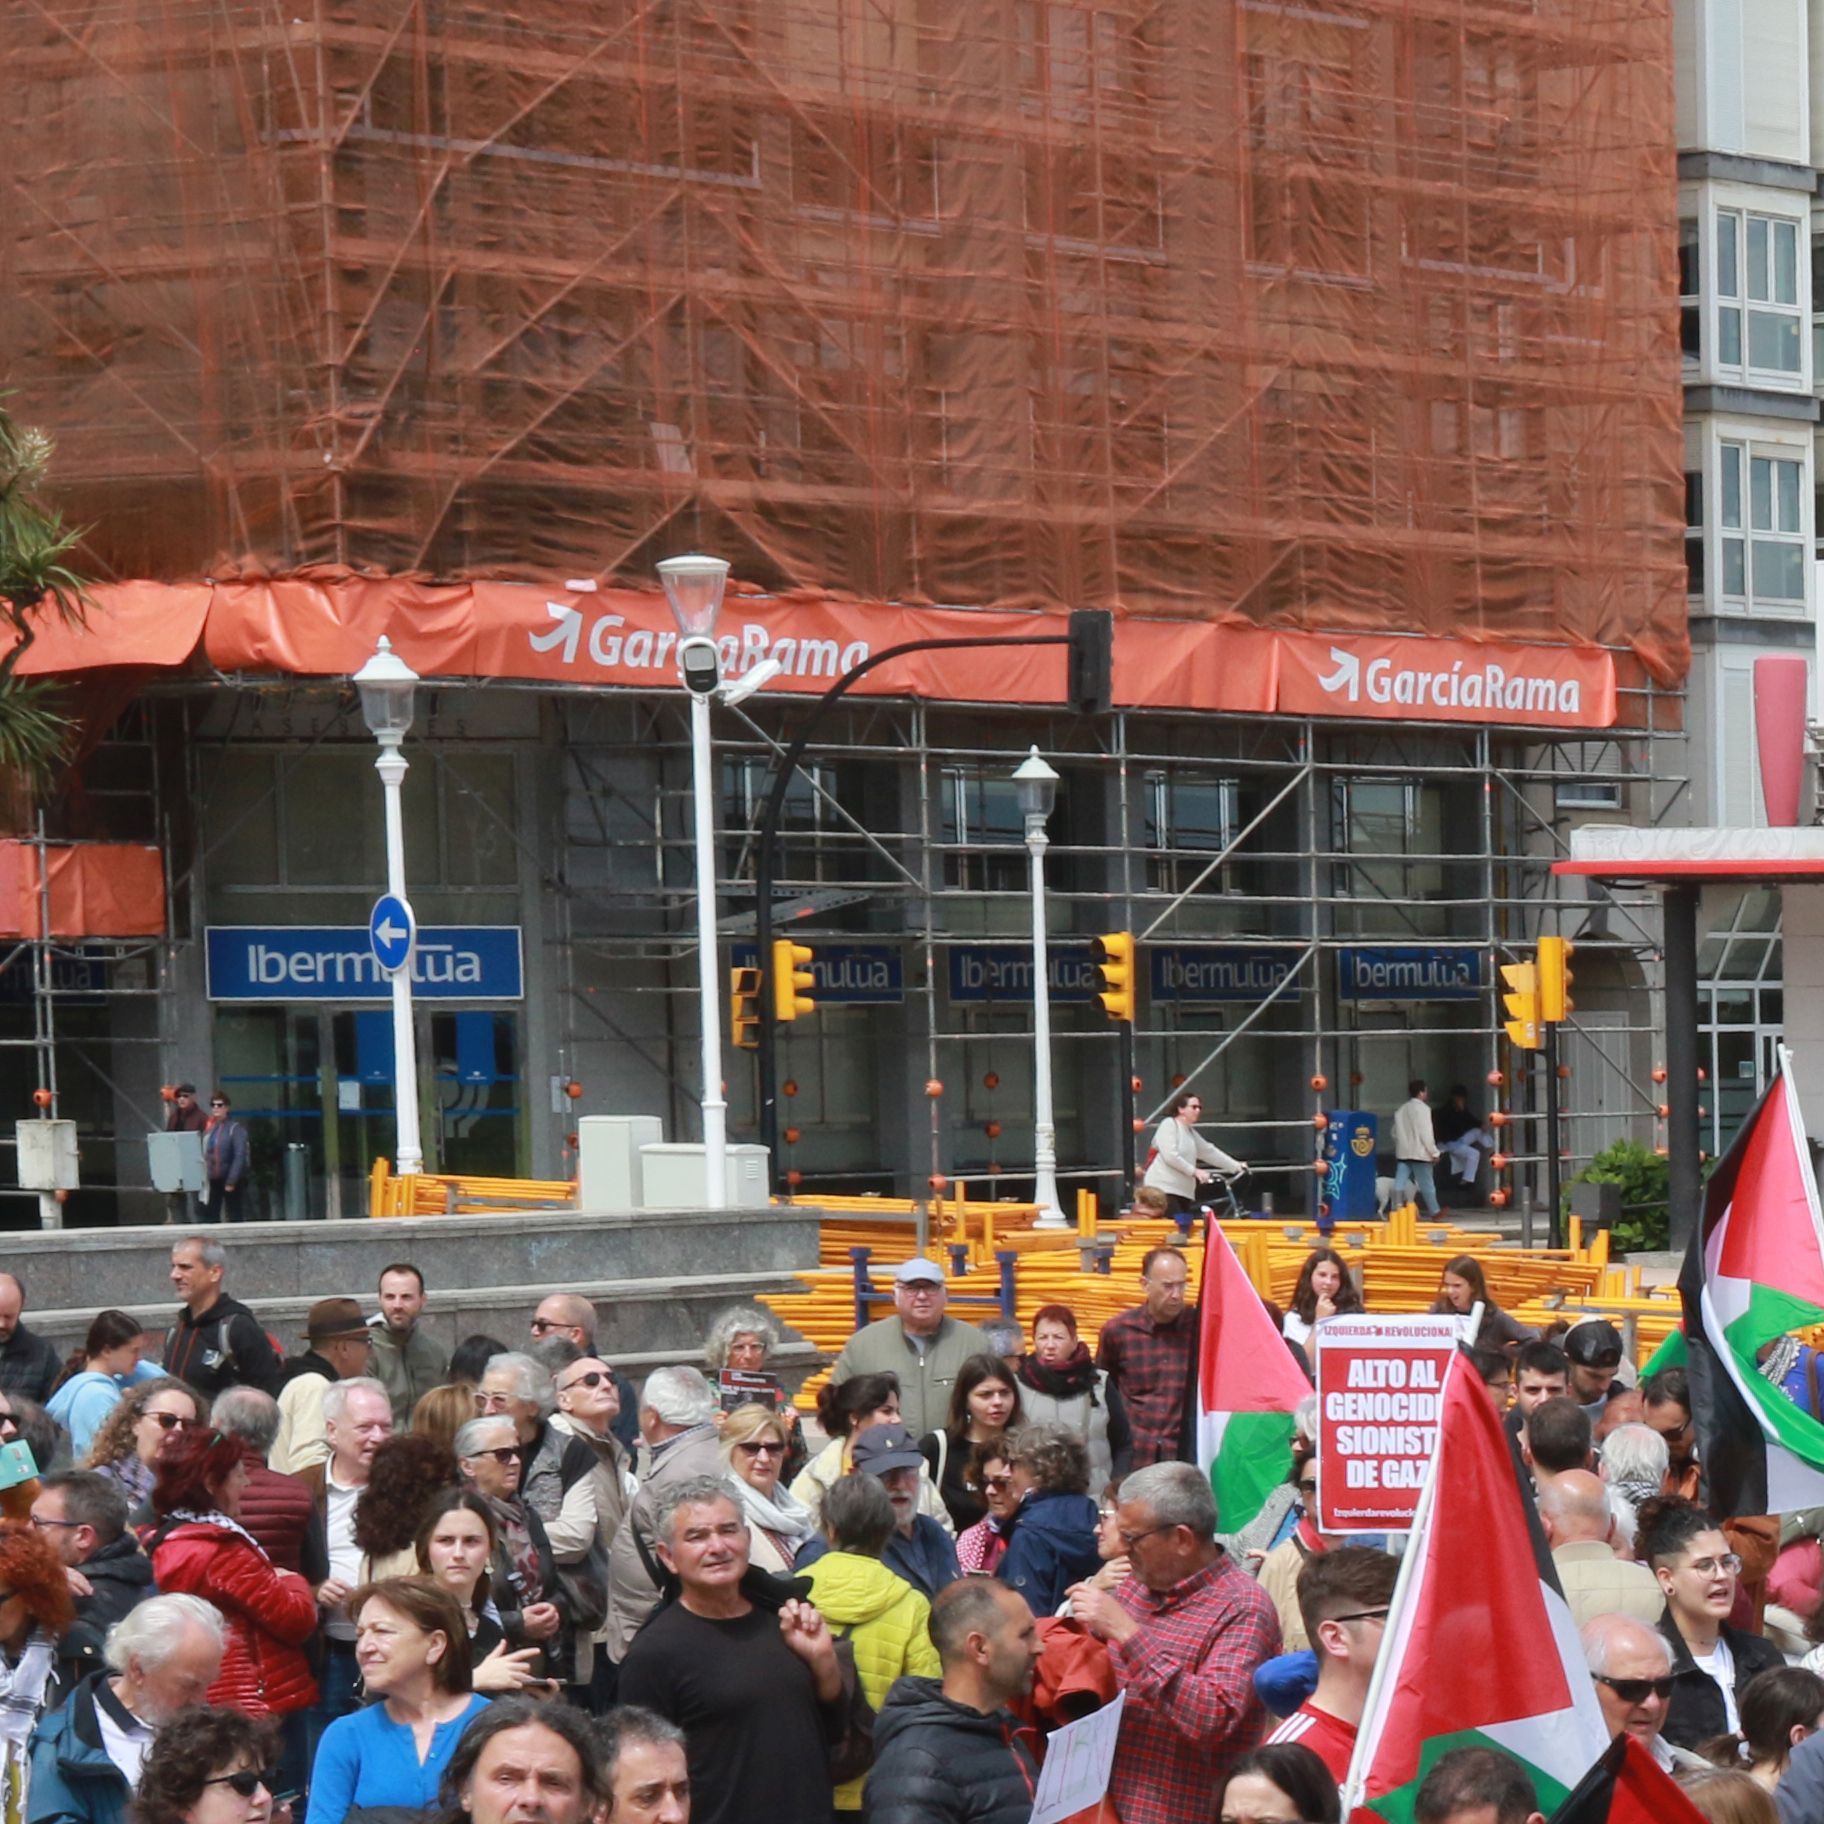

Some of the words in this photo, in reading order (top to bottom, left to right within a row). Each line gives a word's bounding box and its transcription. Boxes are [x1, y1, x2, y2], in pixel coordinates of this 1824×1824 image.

[1366, 656, 1581, 714] GarcíaRama
[247, 943, 481, 984] Ibermtua
[1323, 1325, 1373, 1337] IZQUIERDA
[1347, 1358, 1407, 1389] ALTO
[1408, 1358, 1440, 1389] AL
[1325, 1391, 1440, 1422] GENOCID
[1335, 1424, 1438, 1456] SIONIST
[1346, 1459, 1379, 1489] DE
[1381, 1459, 1430, 1489] GAZ
